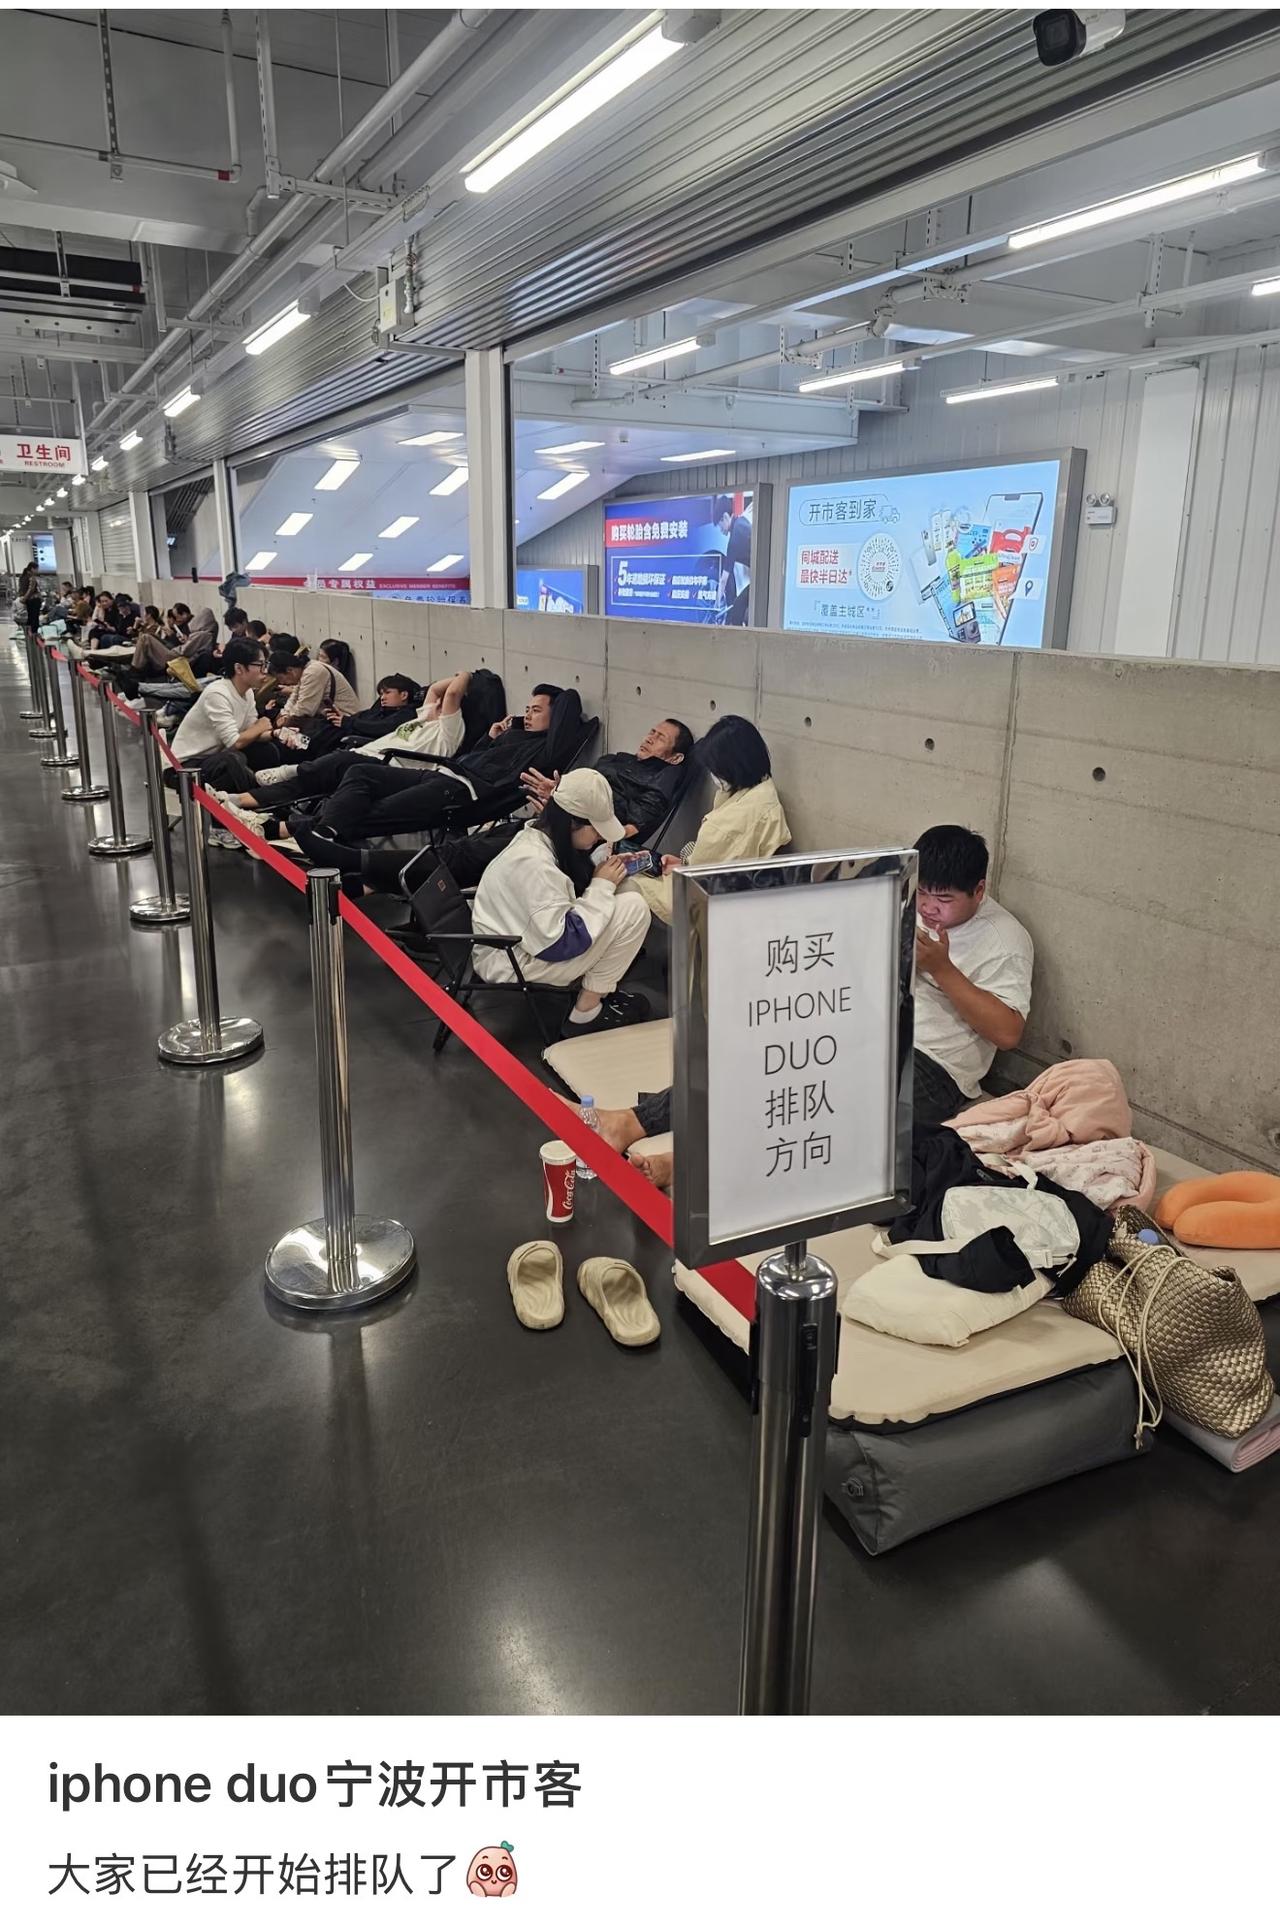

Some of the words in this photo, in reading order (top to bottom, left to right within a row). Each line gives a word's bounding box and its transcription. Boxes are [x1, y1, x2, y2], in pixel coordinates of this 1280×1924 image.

[17, 443, 71, 461] 卫生间
[611, 520, 688, 541] 购买轮胎含免费安装
[809, 499, 878, 522] 开市客到家
[801, 549, 839, 565] 同城配送
[764, 931, 836, 977] 购买
[748, 986, 852, 1028] IPHONE
[764, 1034, 838, 1076] DUO
[765, 1080, 835, 1129] 排队
[765, 1130, 832, 1177] 方向
